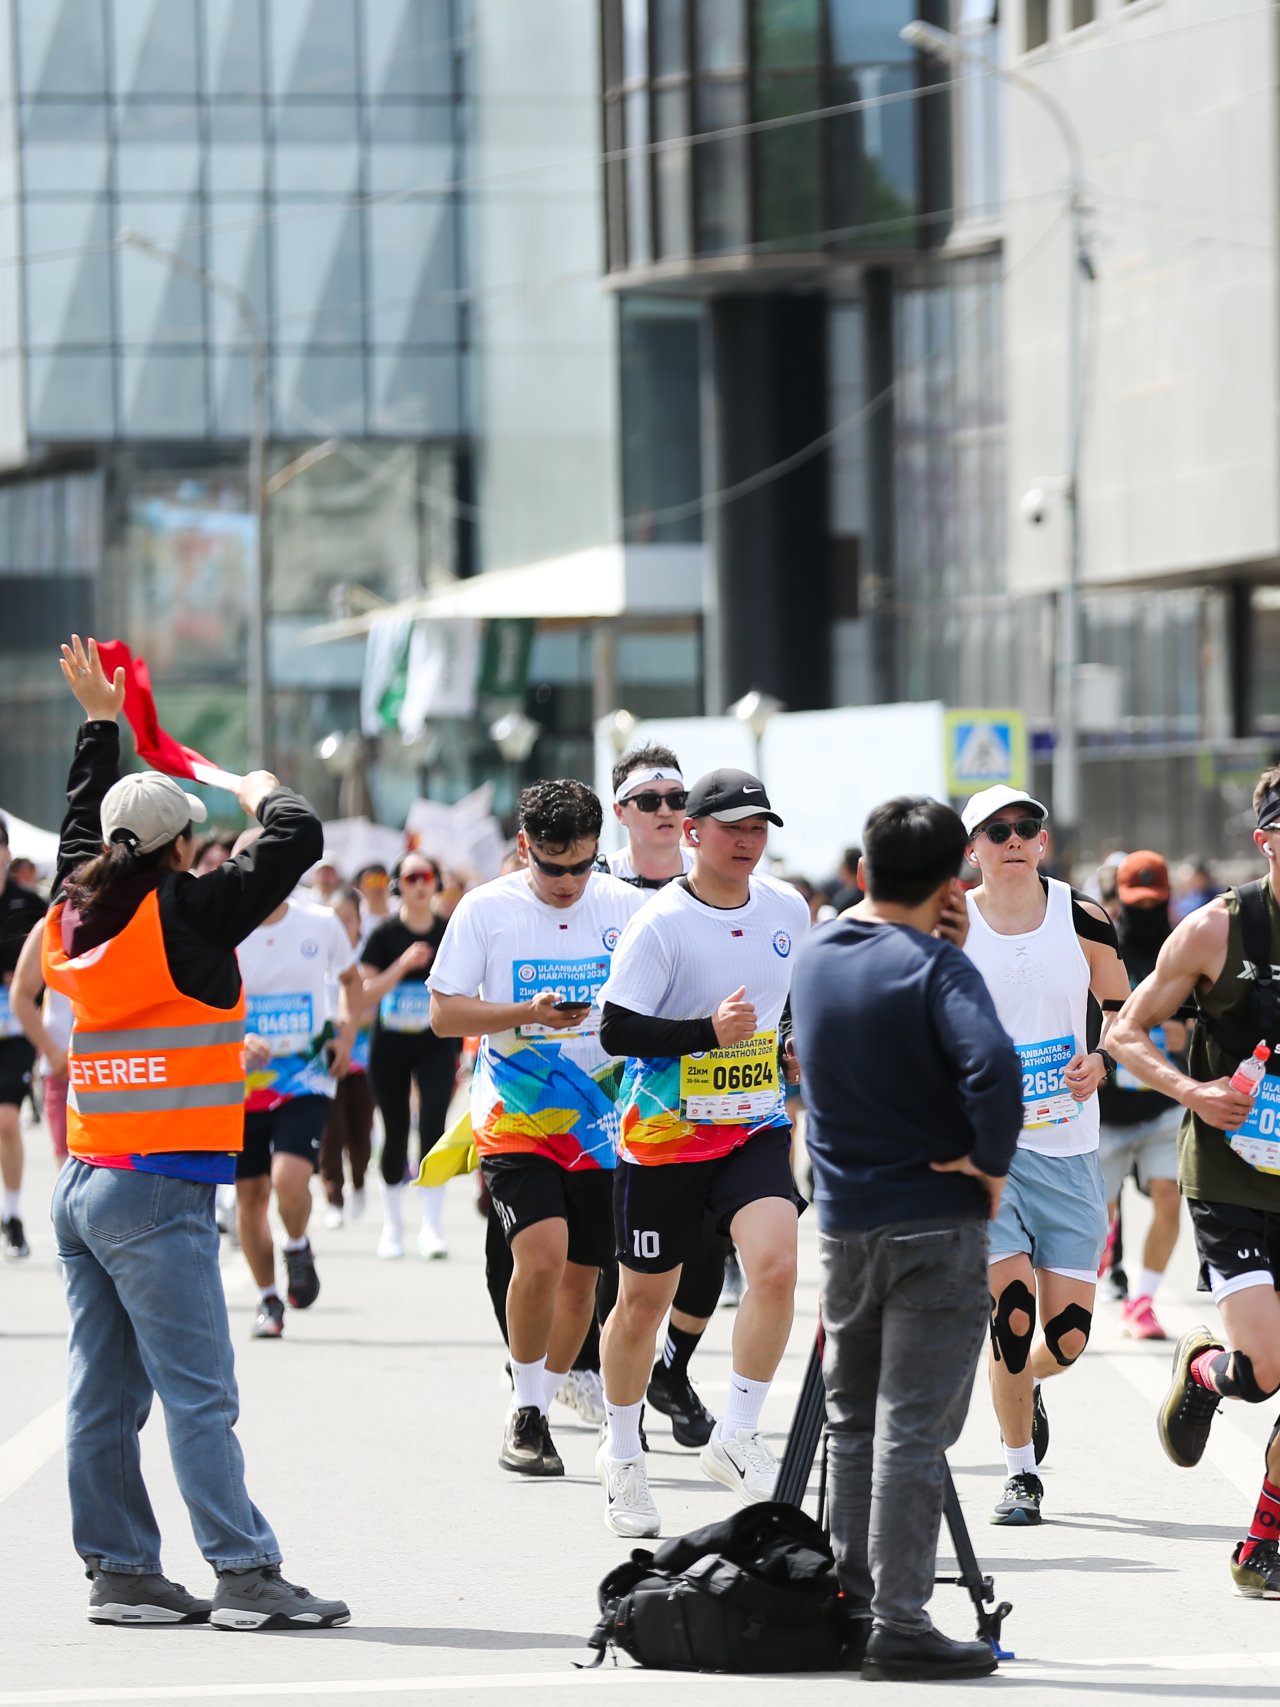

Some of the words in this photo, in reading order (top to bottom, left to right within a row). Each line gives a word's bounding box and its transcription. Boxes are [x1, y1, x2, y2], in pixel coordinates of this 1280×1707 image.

[538, 962, 597, 973] ULAANBAATAR
[538, 972, 586, 981] MARATHON
[587, 969, 607, 979] 2026
[541, 983, 602, 1007] 6125
[709, 1048, 757, 1059] MARATHON
[758, 1045, 773, 1056] 2026
[1016, 1044, 1062, 1060] ANBAATAR
[1052, 1050, 1072, 1062] 2026
[69, 1056, 167, 1085] EFEREE
[713, 1061, 773, 1090] 06624
[1022, 1066, 1068, 1097] 2652
[633, 1230, 660, 1258] 10
